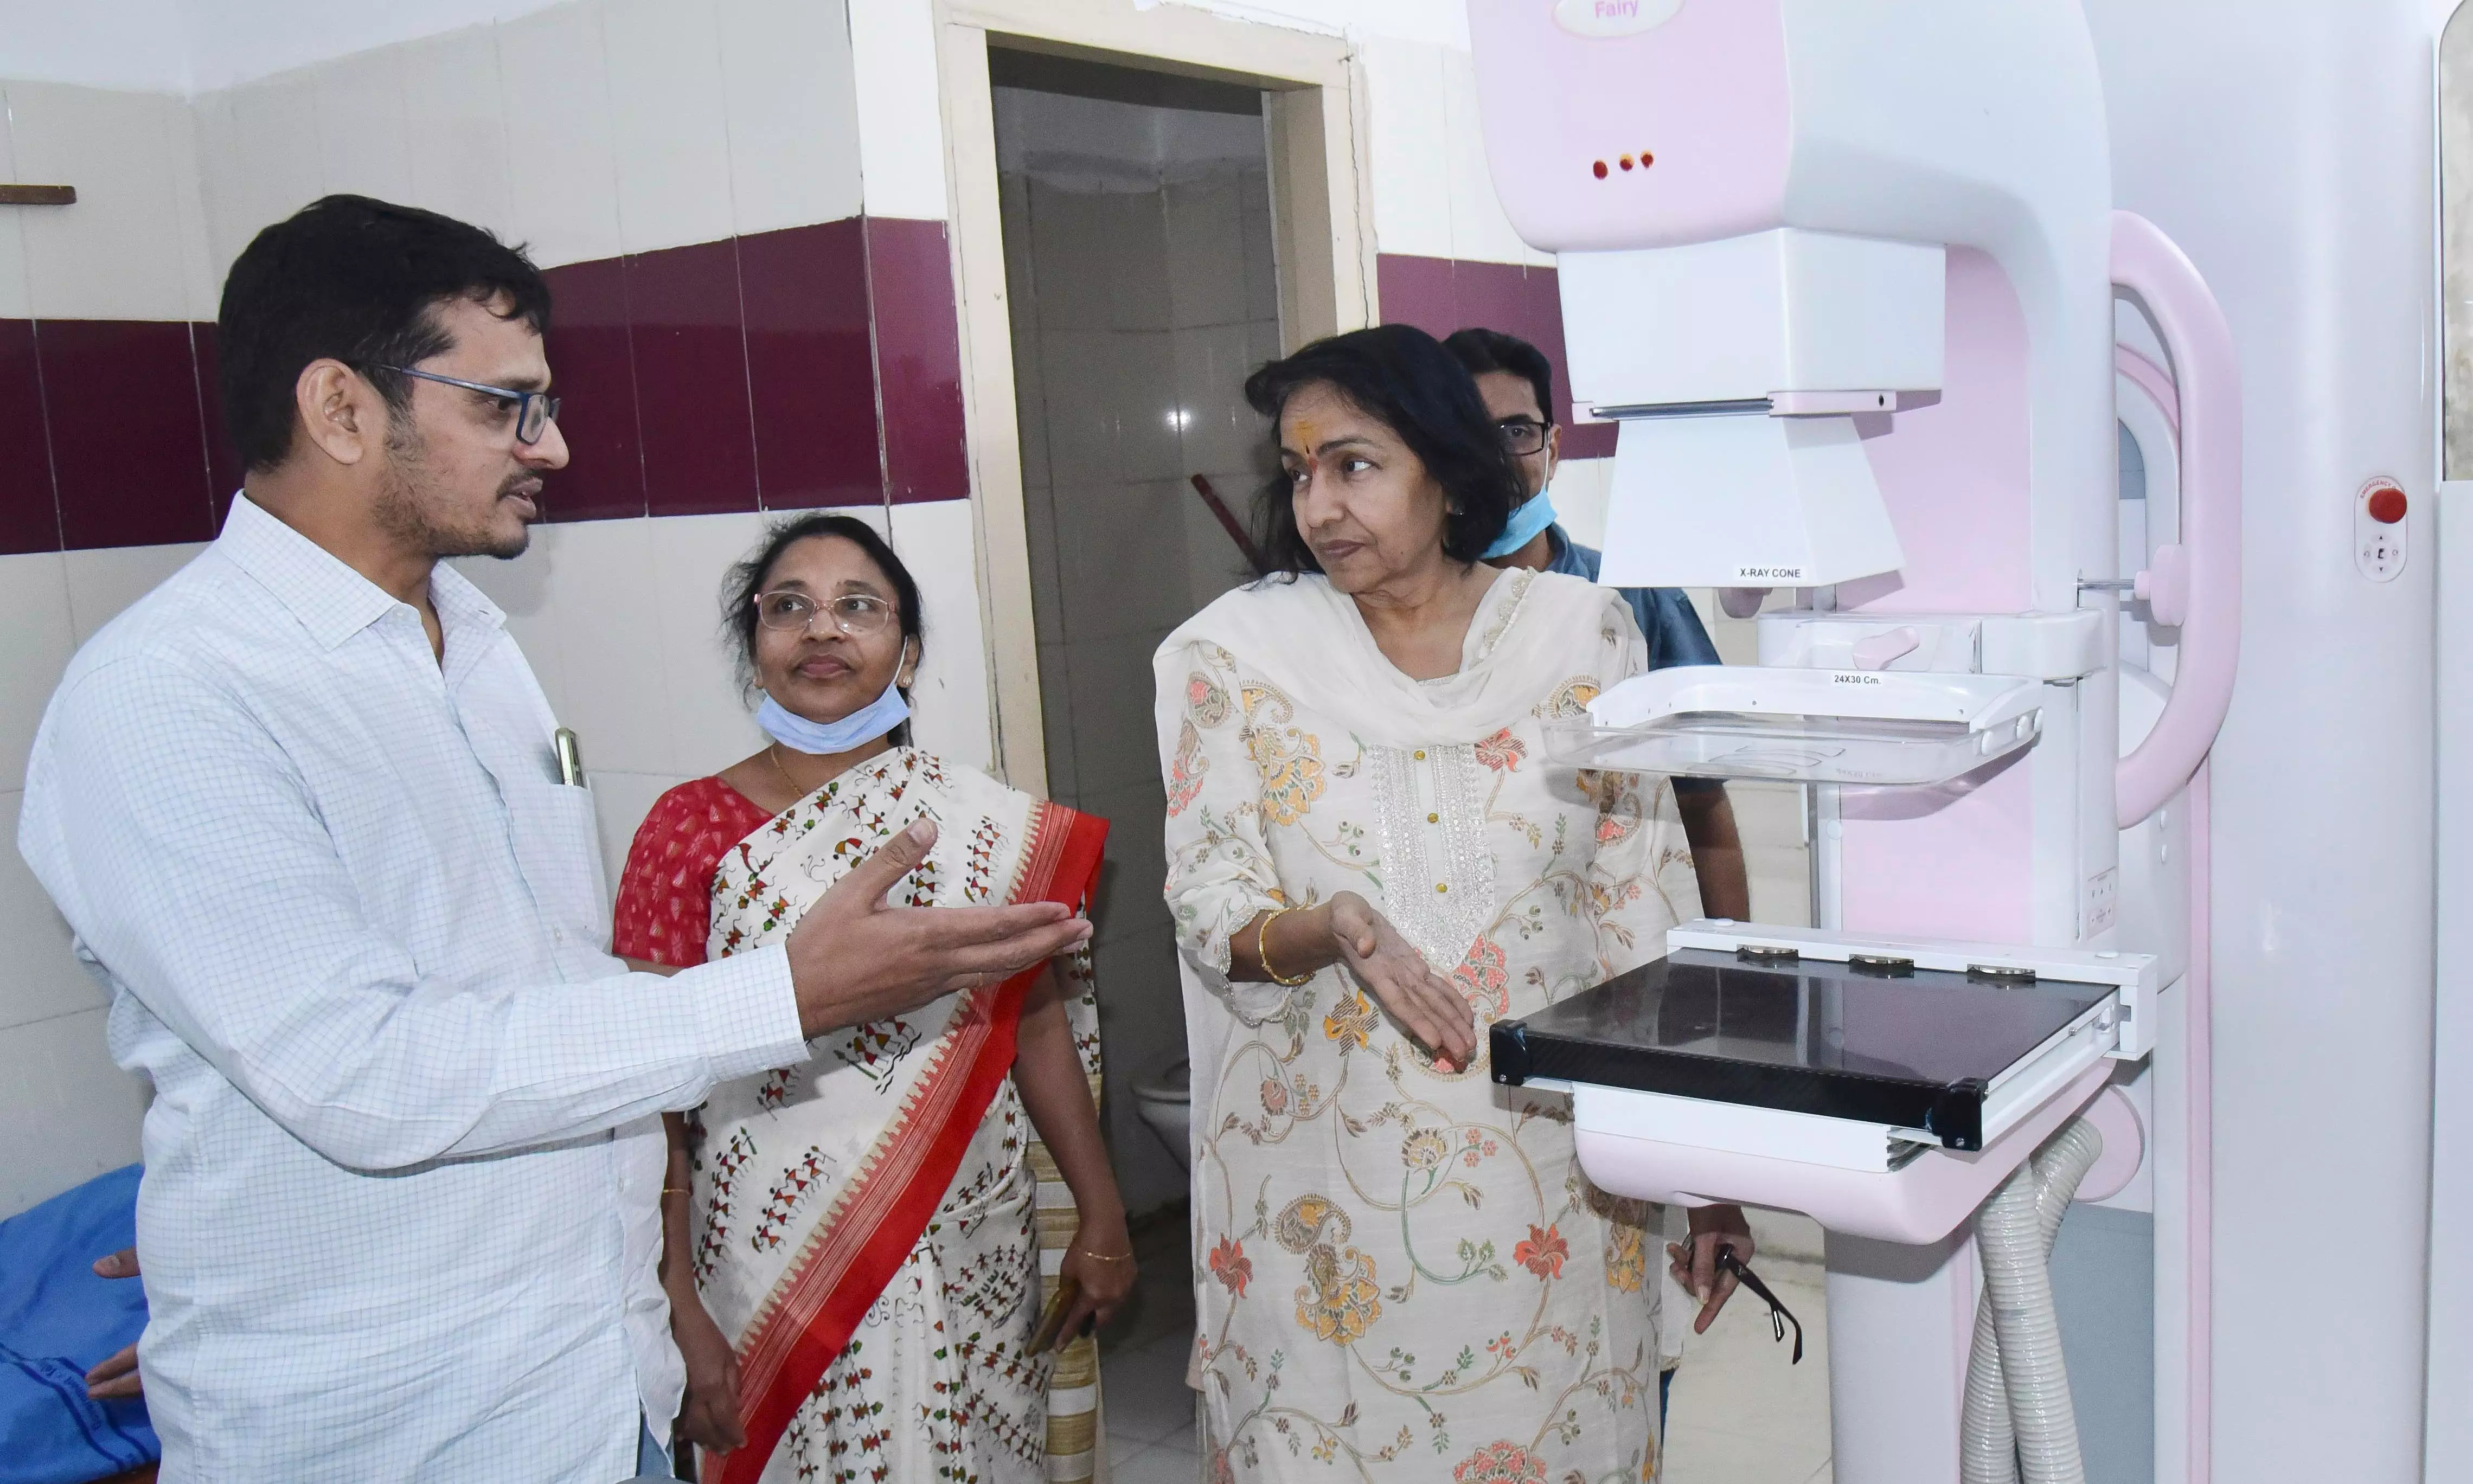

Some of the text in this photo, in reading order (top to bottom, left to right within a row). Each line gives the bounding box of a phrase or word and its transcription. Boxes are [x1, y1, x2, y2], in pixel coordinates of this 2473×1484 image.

[1594, 0, 1638, 19] Fairy
[2360, 479, 2392, 499] EMERGENCY
[1740, 568, 1801, 578] X-RAY CONE
[1834, 674, 1881, 684] 24X30 Cm.
